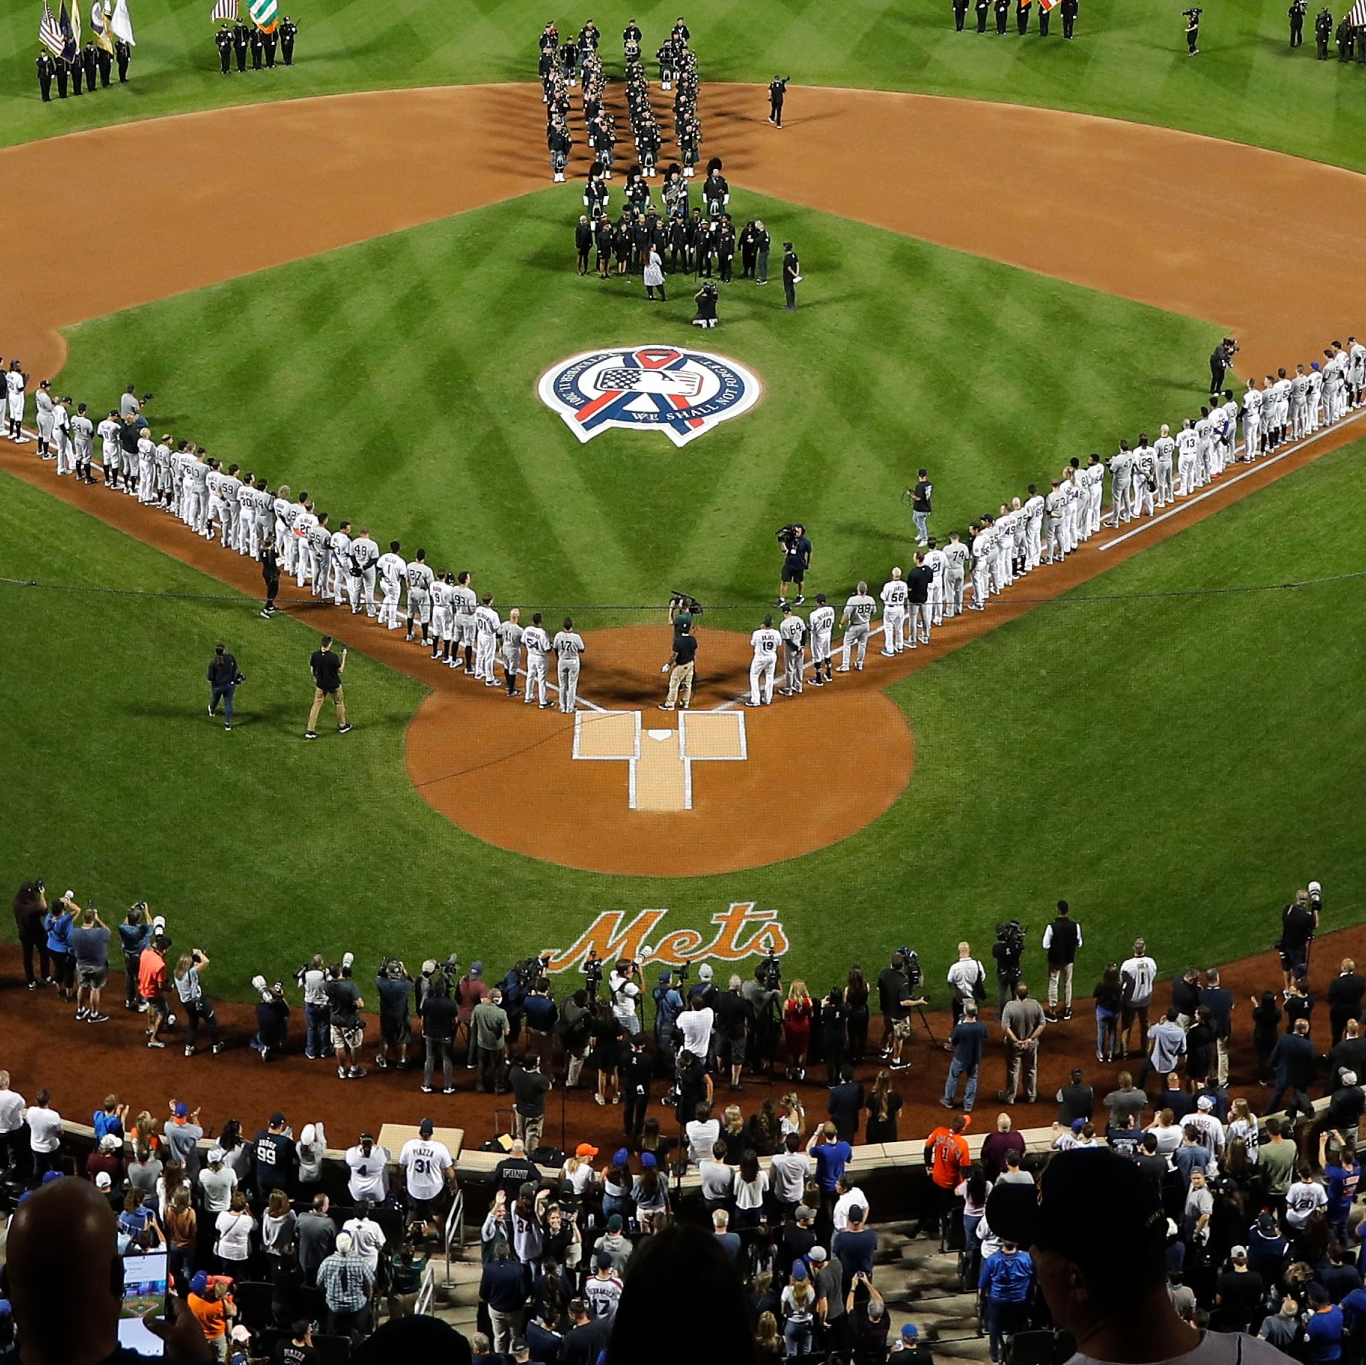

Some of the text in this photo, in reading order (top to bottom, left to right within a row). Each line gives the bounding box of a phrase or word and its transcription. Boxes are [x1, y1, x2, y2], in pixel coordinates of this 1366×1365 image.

[631, 388, 738, 422] WE SHALL NOT
[539, 901, 790, 973] Mets
[257, 1147, 277, 1166] 99
[412, 1148, 436, 1158] PIAZZA
[356, 1164, 368, 1178] 4
[414, 1159, 433, 1175] 31
